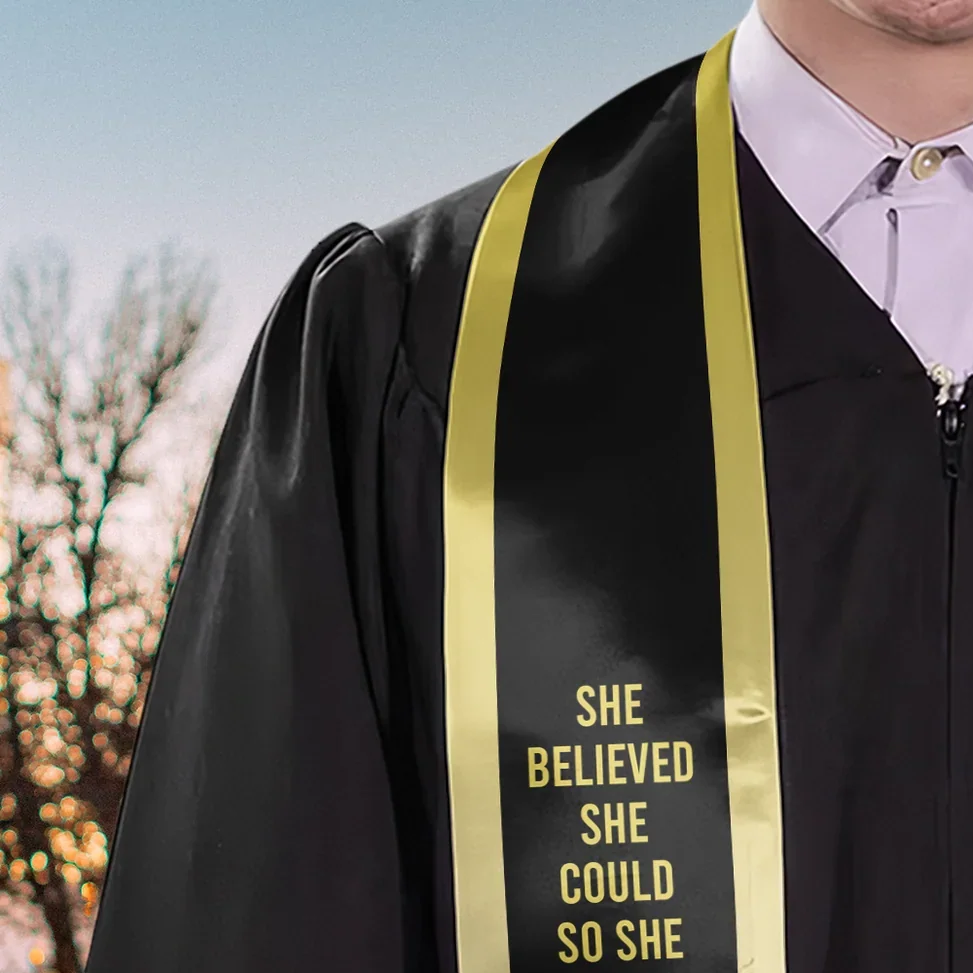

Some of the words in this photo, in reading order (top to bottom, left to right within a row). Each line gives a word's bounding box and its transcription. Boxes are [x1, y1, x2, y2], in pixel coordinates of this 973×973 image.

[576, 684, 643, 727] SHE
[528, 741, 693, 787] BELIEVED
[581, 802, 648, 845] SHE
[560, 859, 674, 904] COULD
[558, 921, 602, 963] SO
[616, 918, 684, 961] SHE
